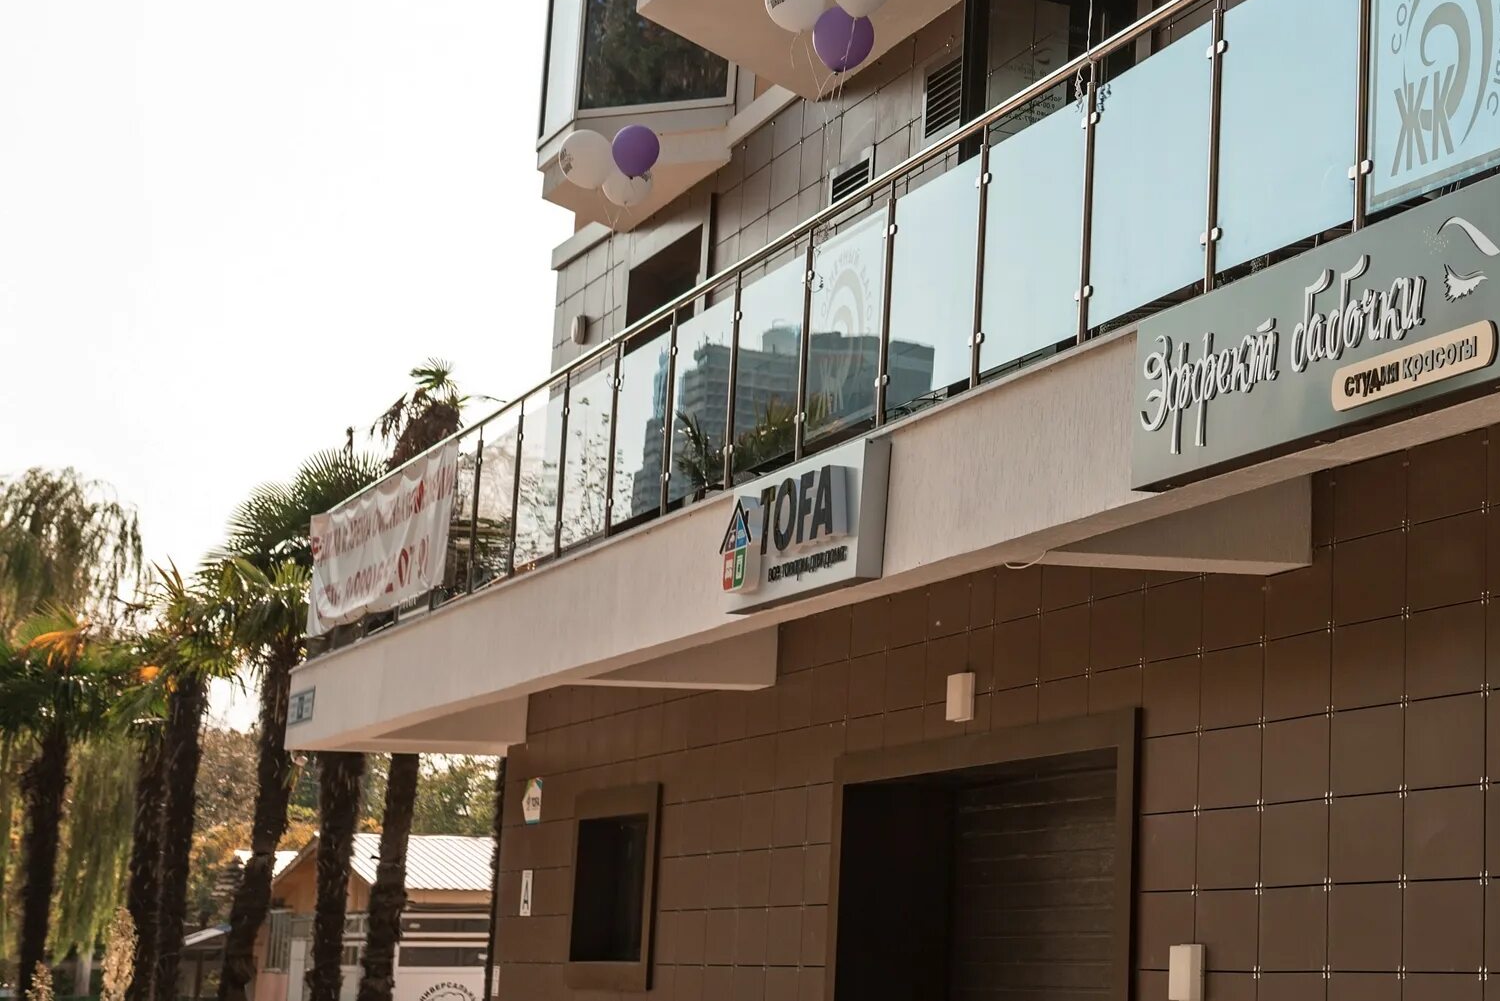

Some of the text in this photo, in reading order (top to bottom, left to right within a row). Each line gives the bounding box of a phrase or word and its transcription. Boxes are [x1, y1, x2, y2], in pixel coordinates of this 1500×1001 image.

[1140, 254, 1426, 454] Эффект бабочки
[1344, 336, 1478, 397] студия красоты
[760, 464, 834, 556] TOFA
